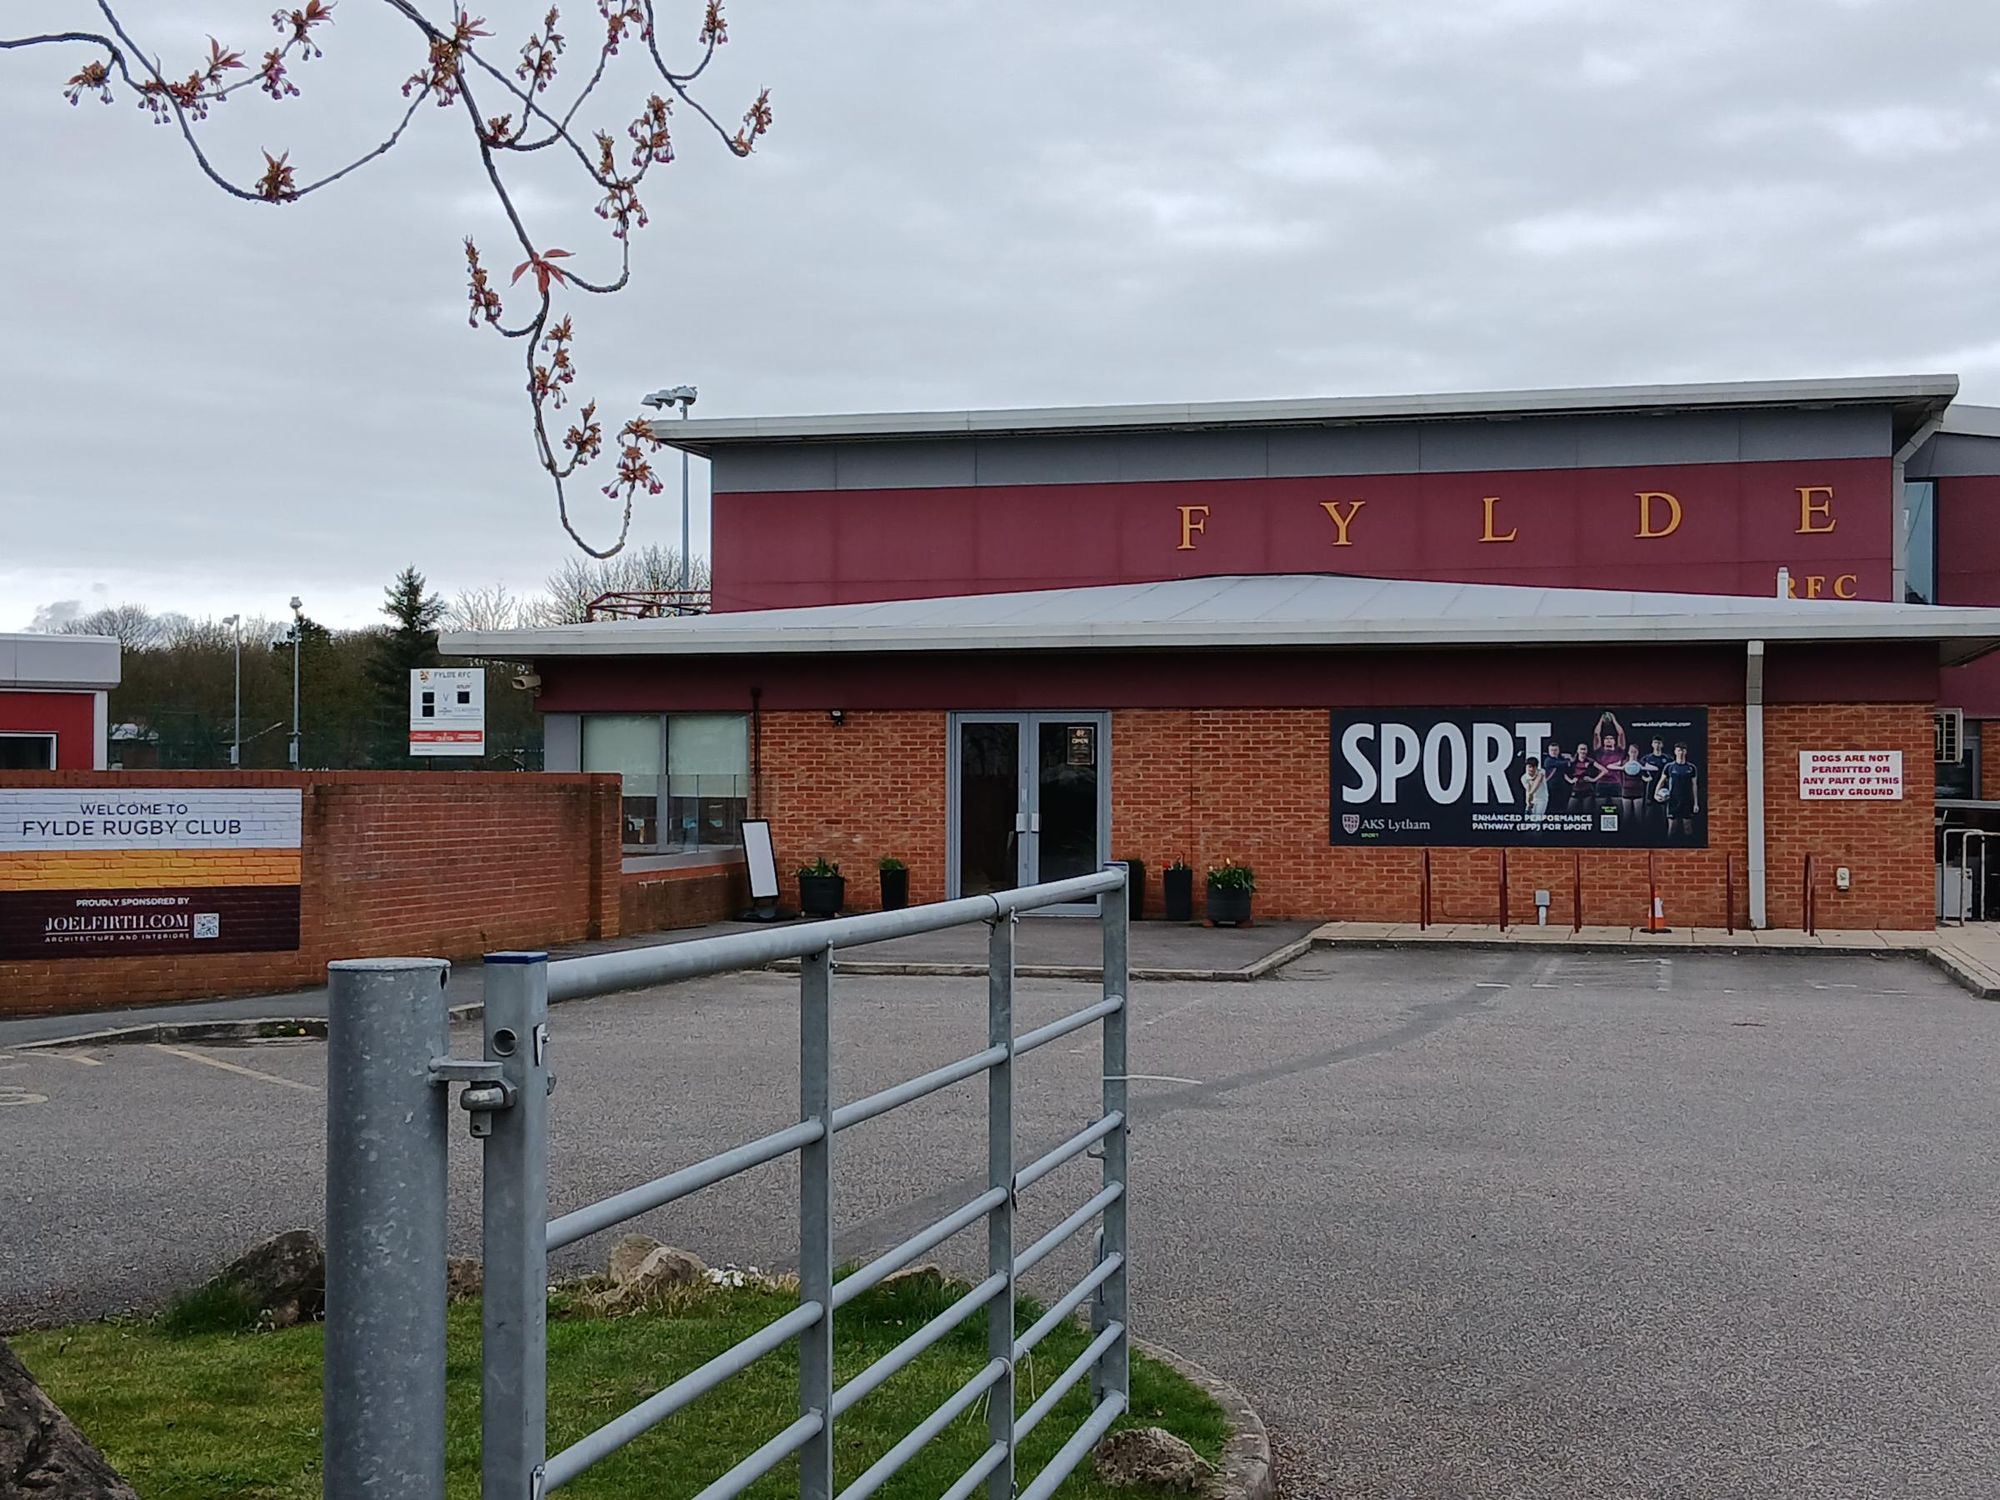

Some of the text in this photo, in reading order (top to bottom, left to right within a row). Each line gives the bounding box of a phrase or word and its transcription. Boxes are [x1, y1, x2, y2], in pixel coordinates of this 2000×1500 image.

[1176, 485, 1837, 551] FYLDE
[1341, 721, 1552, 804] SPORT
[1811, 766, 1890, 774] PERMITTED ON
[1803, 777, 1900, 785] ANY PART OF THIS
[1808, 788, 1894, 796] RUGBY GROUND
[80, 803, 188, 815] WELCOME TO
[1472, 814, 1593, 822] ENHANCED PERFORMANCE
[22, 819, 242, 836] FYLDE RUGBY CLUB
[1361, 819, 1431, 832] AKS Lytham
[1472, 823, 1593, 831] PATHWAY (EPP) FOR SPORT
[76, 897, 190, 907] PROUDLY SPONSORED BY
[45, 914, 188, 931] JOELFIRTH.COM
